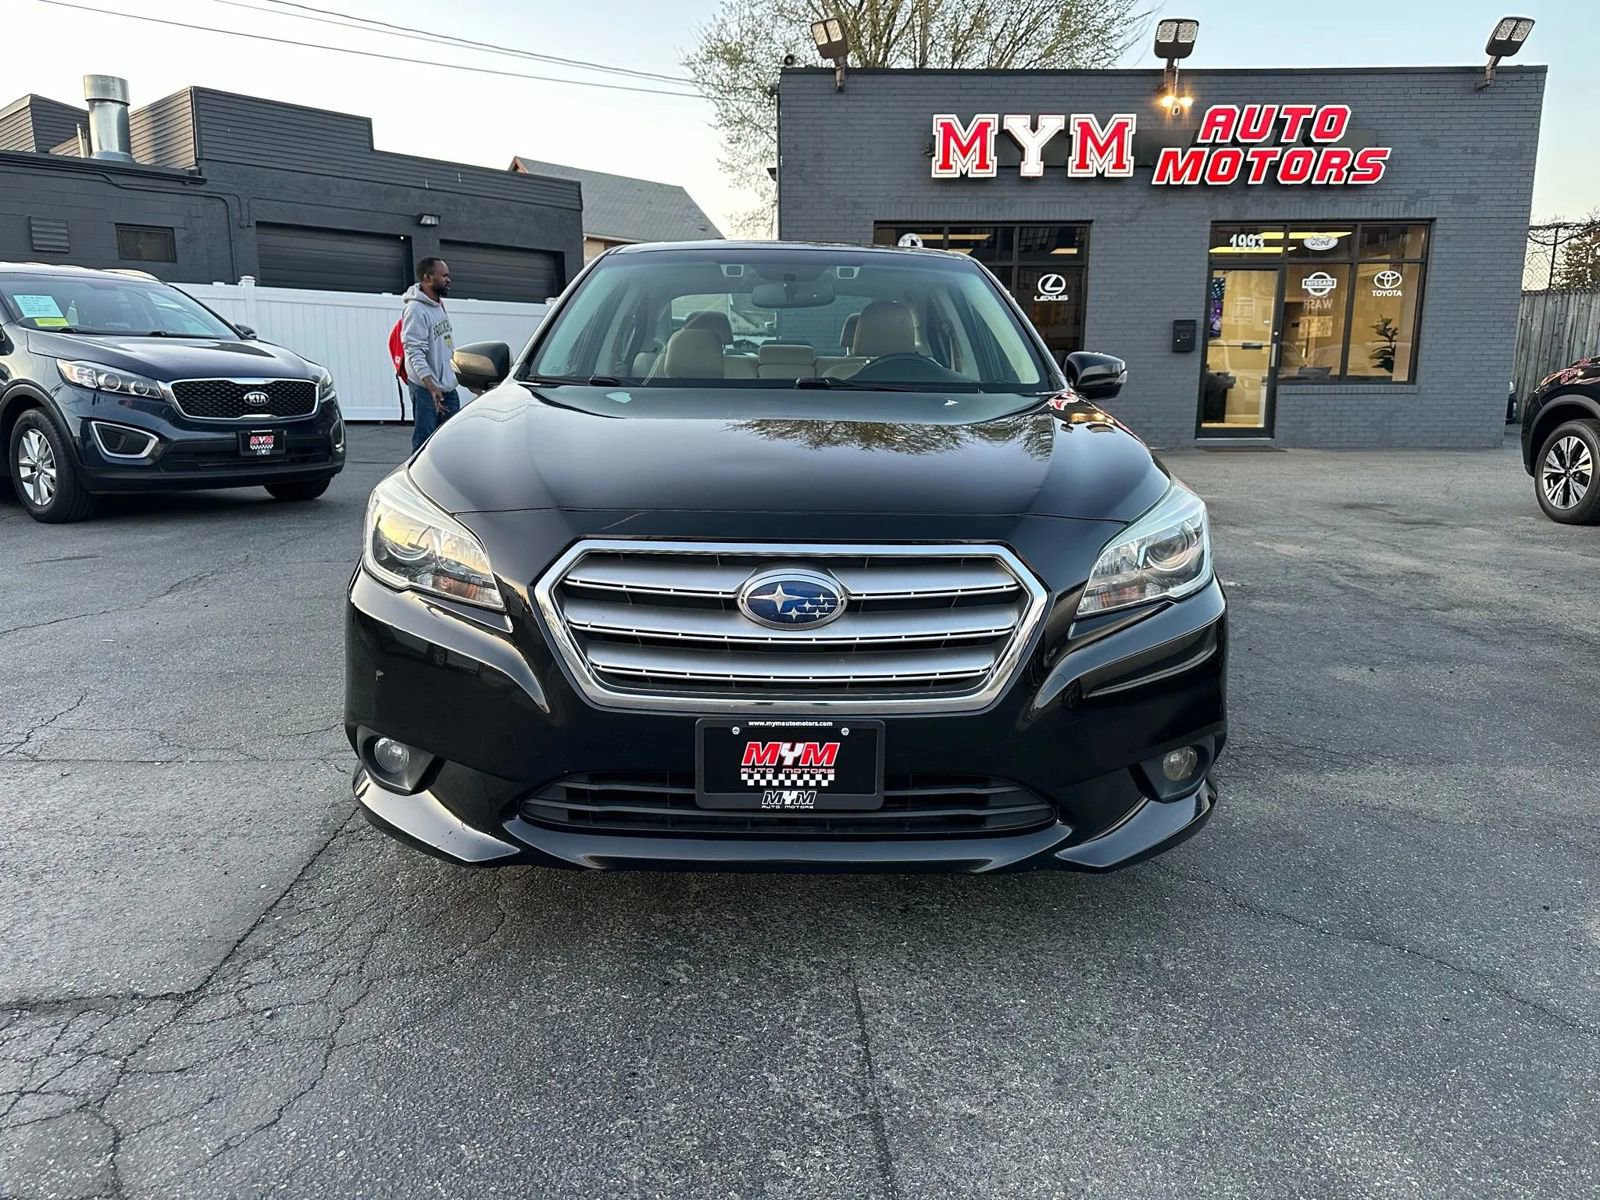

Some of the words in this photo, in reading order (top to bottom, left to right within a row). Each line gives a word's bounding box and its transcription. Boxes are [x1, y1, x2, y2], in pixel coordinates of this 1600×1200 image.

[1197, 104, 1352, 143] AUTO
[931, 113, 1137, 178] MYM
[1151, 147, 1393, 186] MOTORS
[1229, 233, 1265, 250] 1993
[1033, 294, 1069, 302] LEXUS
[1371, 289, 1403, 297] TOYOTA
[248, 394, 267, 403] KIA
[741, 741, 841, 767] MYM
[761, 790, 817, 805] MYM
